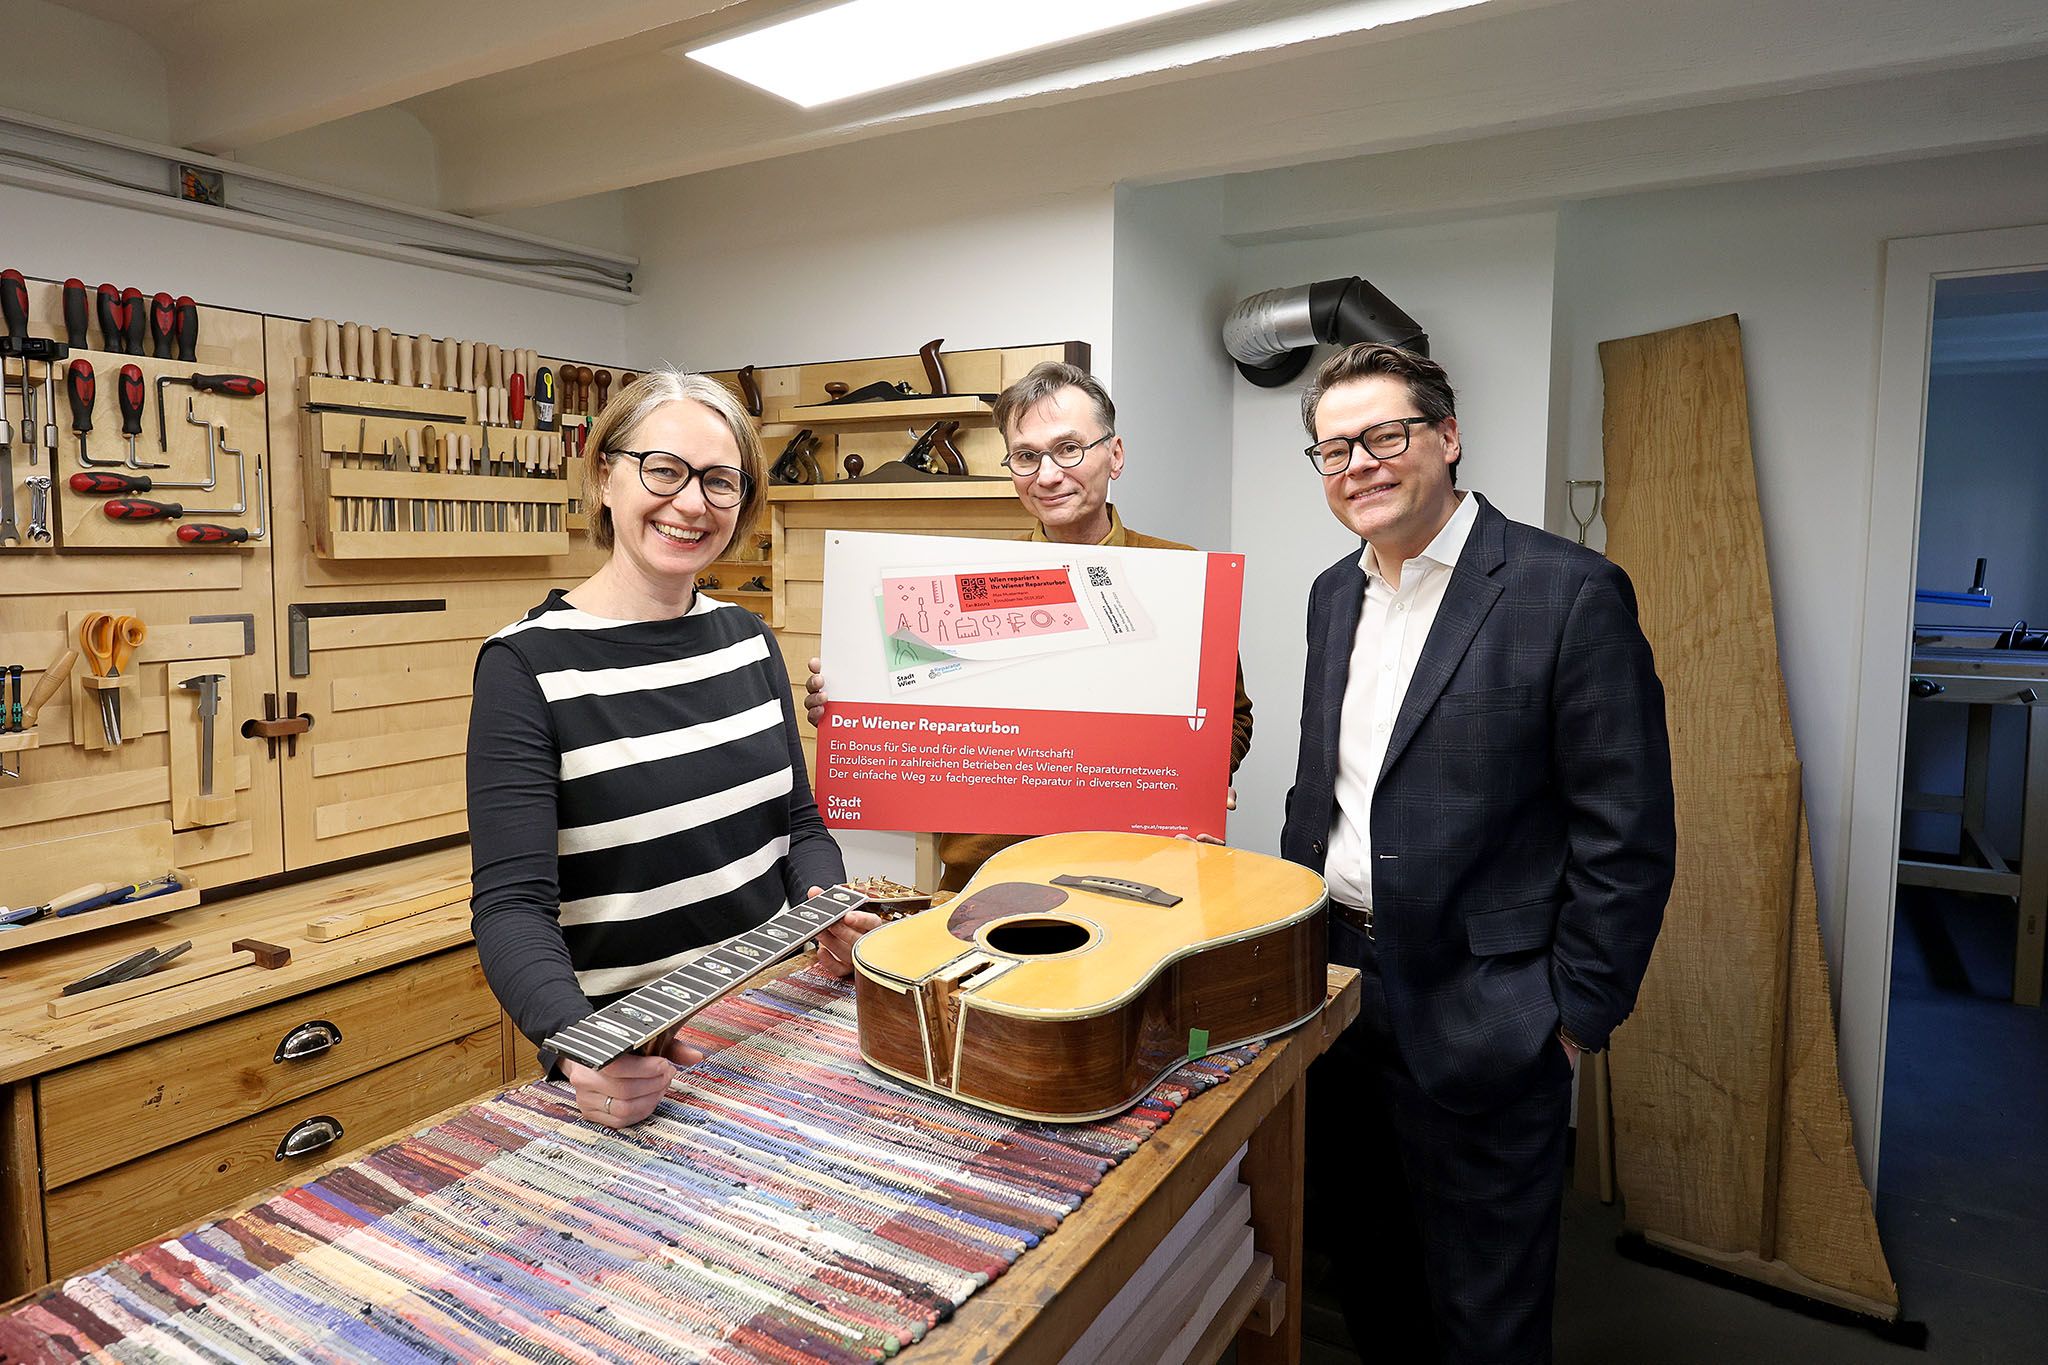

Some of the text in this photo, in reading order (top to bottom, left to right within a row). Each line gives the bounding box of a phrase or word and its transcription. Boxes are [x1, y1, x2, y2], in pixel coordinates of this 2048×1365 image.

[896, 673, 915, 681] Stadt
[897, 679, 916, 687] Wien
[831, 714, 1020, 735] Der Wiener Reparaturbon
[830, 739, 1074, 760] Ein Bonus für Sie und für die Wiener Wirtschaft!
[829, 753, 1179, 778] Einzulösen in zahlreichen Betrieben des Wiener Reparaturnetzwerks.
[829, 768, 1179, 793] Der einfache Weg zu fachgerechter Reparatur in diversen Sparten.
[828, 795, 861, 808] Stadt
[827, 807, 861, 820] Wien
[1131, 824, 1189, 832] wien.gv.at/reparaturbon
